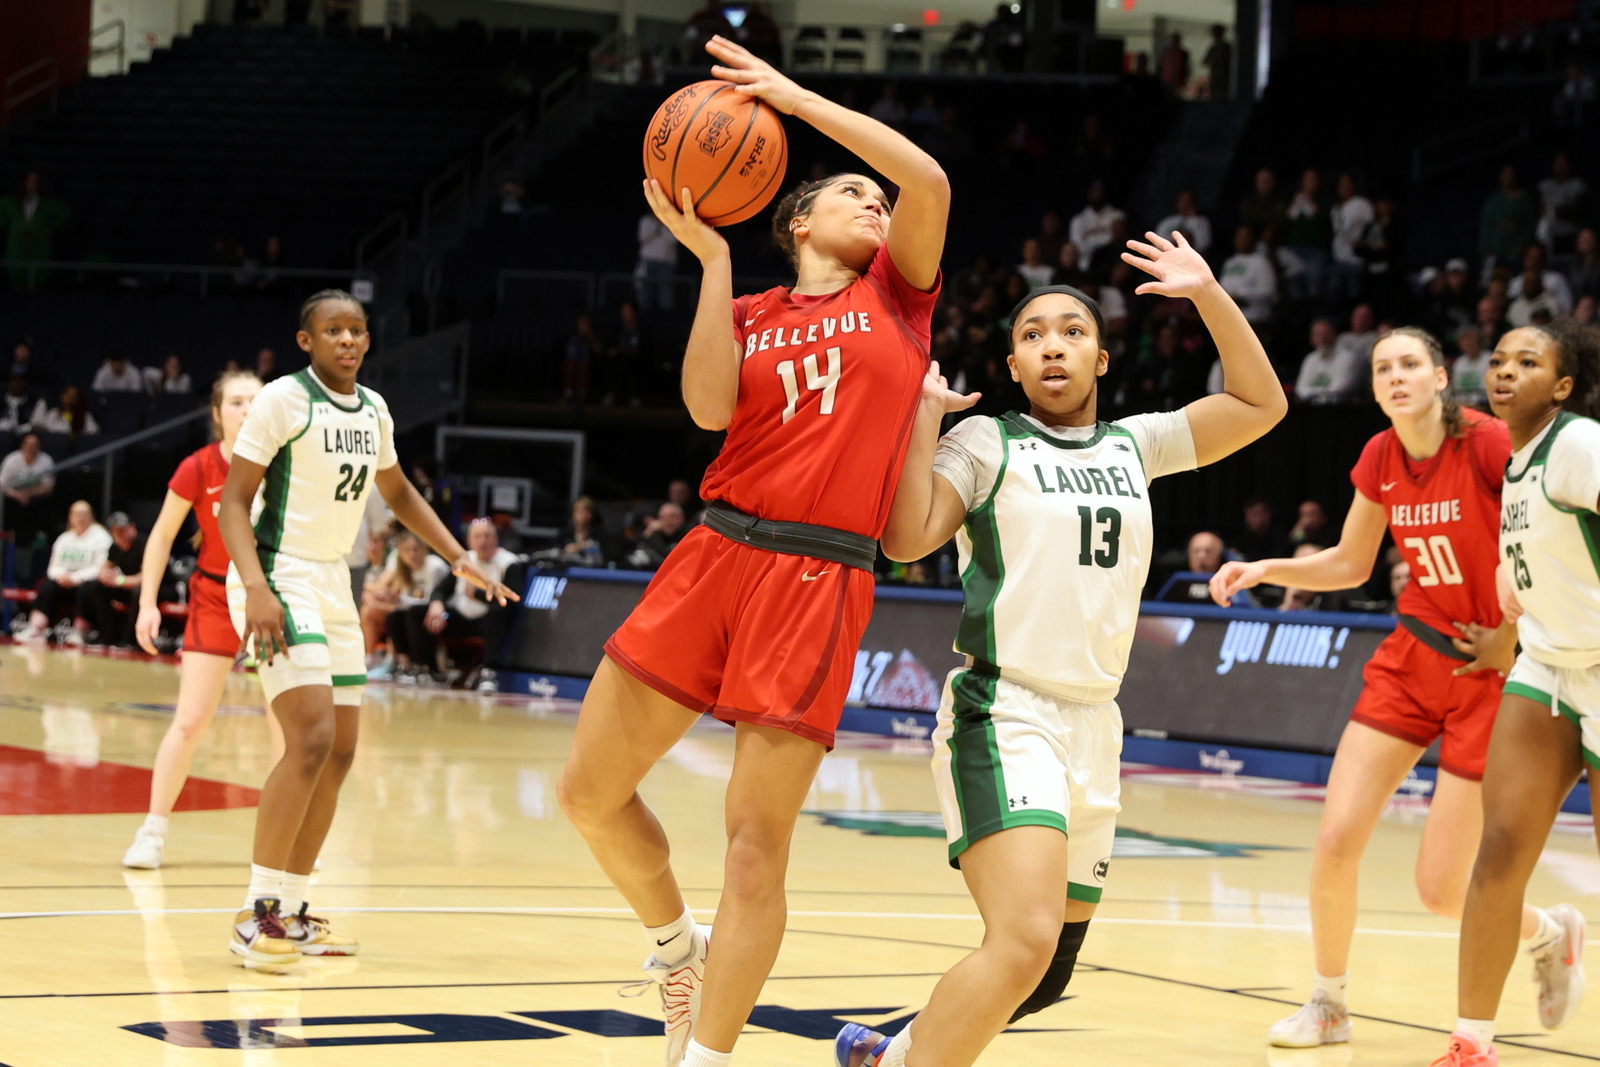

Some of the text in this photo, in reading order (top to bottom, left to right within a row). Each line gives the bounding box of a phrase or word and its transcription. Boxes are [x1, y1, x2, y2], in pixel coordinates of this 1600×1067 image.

[702, 112, 733, 155] OHSAA
[745, 136, 766, 170] NFHS
[744, 310, 873, 360] BELLEVUE
[776, 346, 841, 425] 14
[324, 428, 377, 456] LAUREL
[334, 463, 368, 502] 24
[1033, 463, 1142, 499] LAUREL
[1077, 505, 1122, 569] 13
[1403, 535, 1464, 587] 30
[1506, 542, 1533, 591] 25
